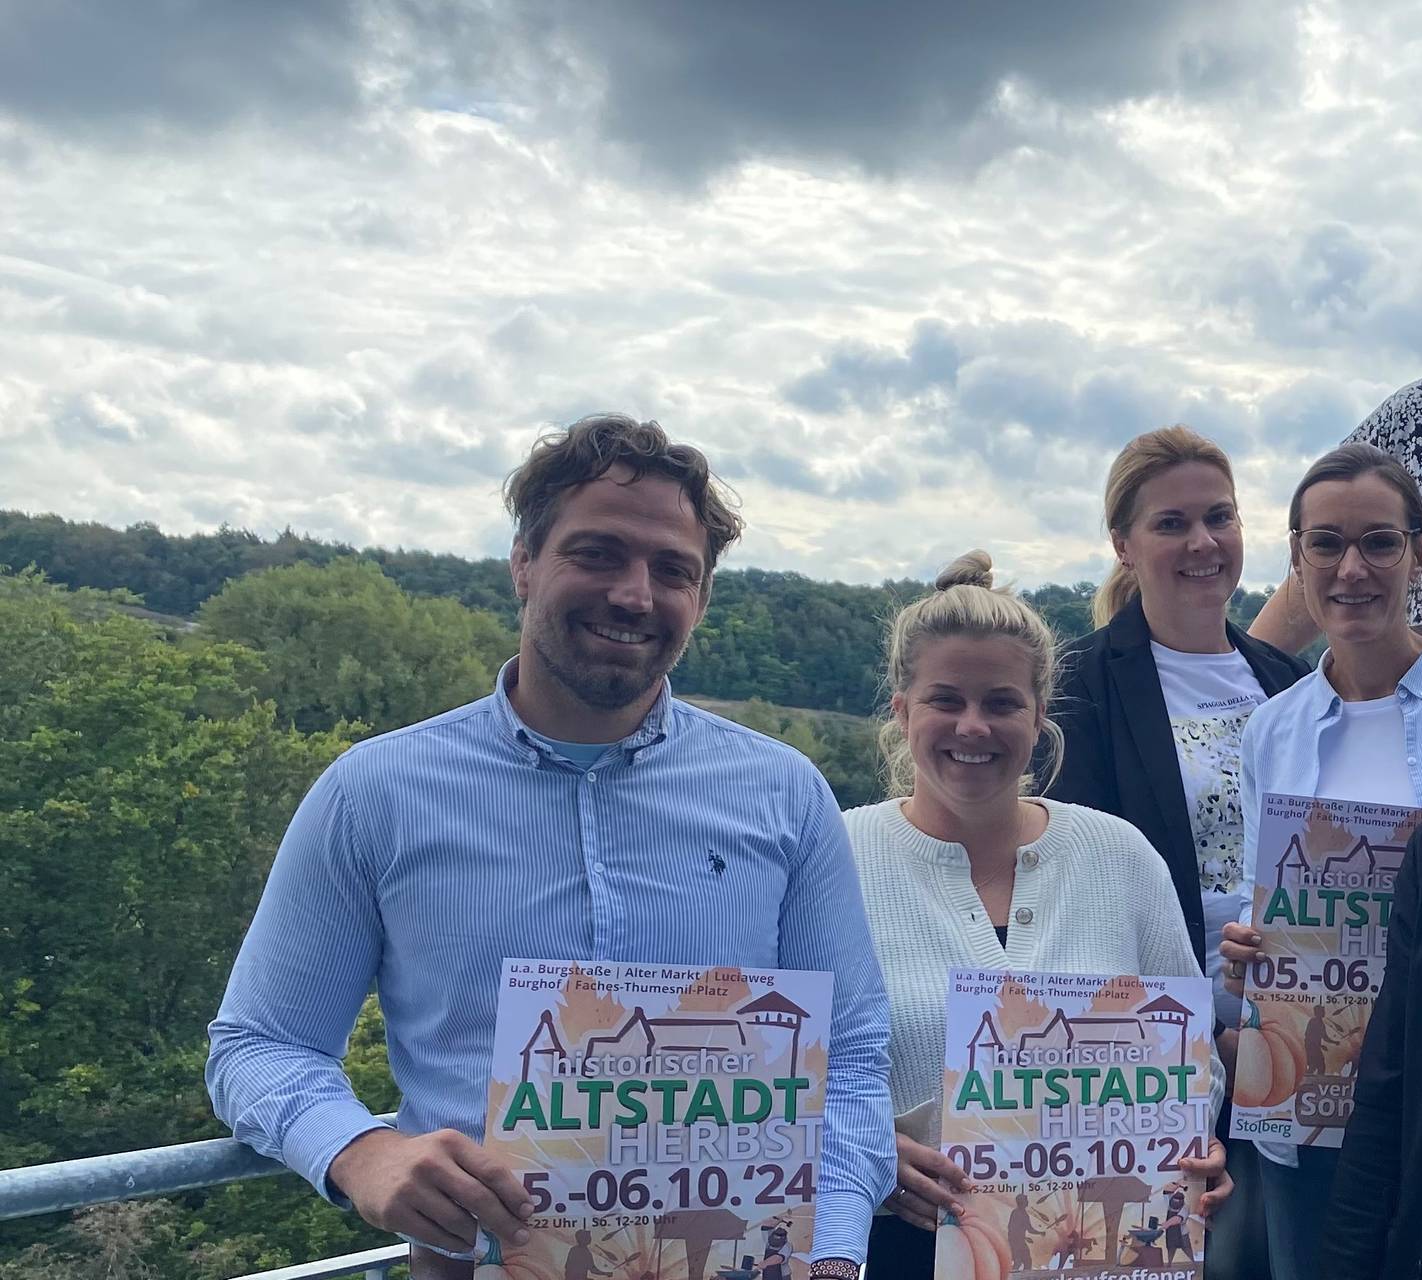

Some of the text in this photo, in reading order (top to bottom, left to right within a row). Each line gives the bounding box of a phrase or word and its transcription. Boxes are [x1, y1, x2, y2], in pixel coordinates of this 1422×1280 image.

[1267, 807, 1307, 819] Burghof
[1288, 798, 1343, 812] Burgstraße
[1354, 804, 1379, 815] Alter
[1381, 808, 1410, 818] Markt
[1300, 865, 1393, 889] historis
[1263, 888, 1395, 928] ALTST
[510, 964, 775, 986] u.a. Burgstraße Alter Markt Luciaweg
[956, 973, 1166, 990] u.a. Burgstraße Alter Markt Luciaweg
[1252, 958, 1379, 993] 05.-06.
[509, 977, 728, 997] Burghof Faches-Thumesnil-Platz
[955, 984, 1130, 1000] Burghof Faches-Thumesnil-Platz
[1270, 994, 1296, 1002] 15-22
[1298, 994, 1316, 1003] Uhr
[1326, 996, 1340, 1004] So.
[1344, 996, 1368, 1005] 12-20
[552, 1048, 756, 1078] historischer
[993, 1043, 1152, 1066] historischer
[956, 1065, 1196, 1110] ALTSTADT
[503, 1078, 809, 1132] ALTSTADT
[1040, 1098, 1209, 1138] HERBST
[1236, 1118, 1292, 1138] Stolberg
[611, 1117, 823, 1165] HERBST
[522, 1163, 817, 1213] 5.-06.10.‘24
[998, 1183, 1017, 1193] Uhr
[1028, 1182, 1043, 1192] So.
[1047, 1181, 1073, 1191] 12-20
[1077, 1181, 1096, 1190] Uhr
[553, 1217, 577, 1229] Uhr
[592, 1218, 611, 1228] So.
[616, 1215, 649, 1227] 12-20
[653, 1215, 677, 1226] Uhr
